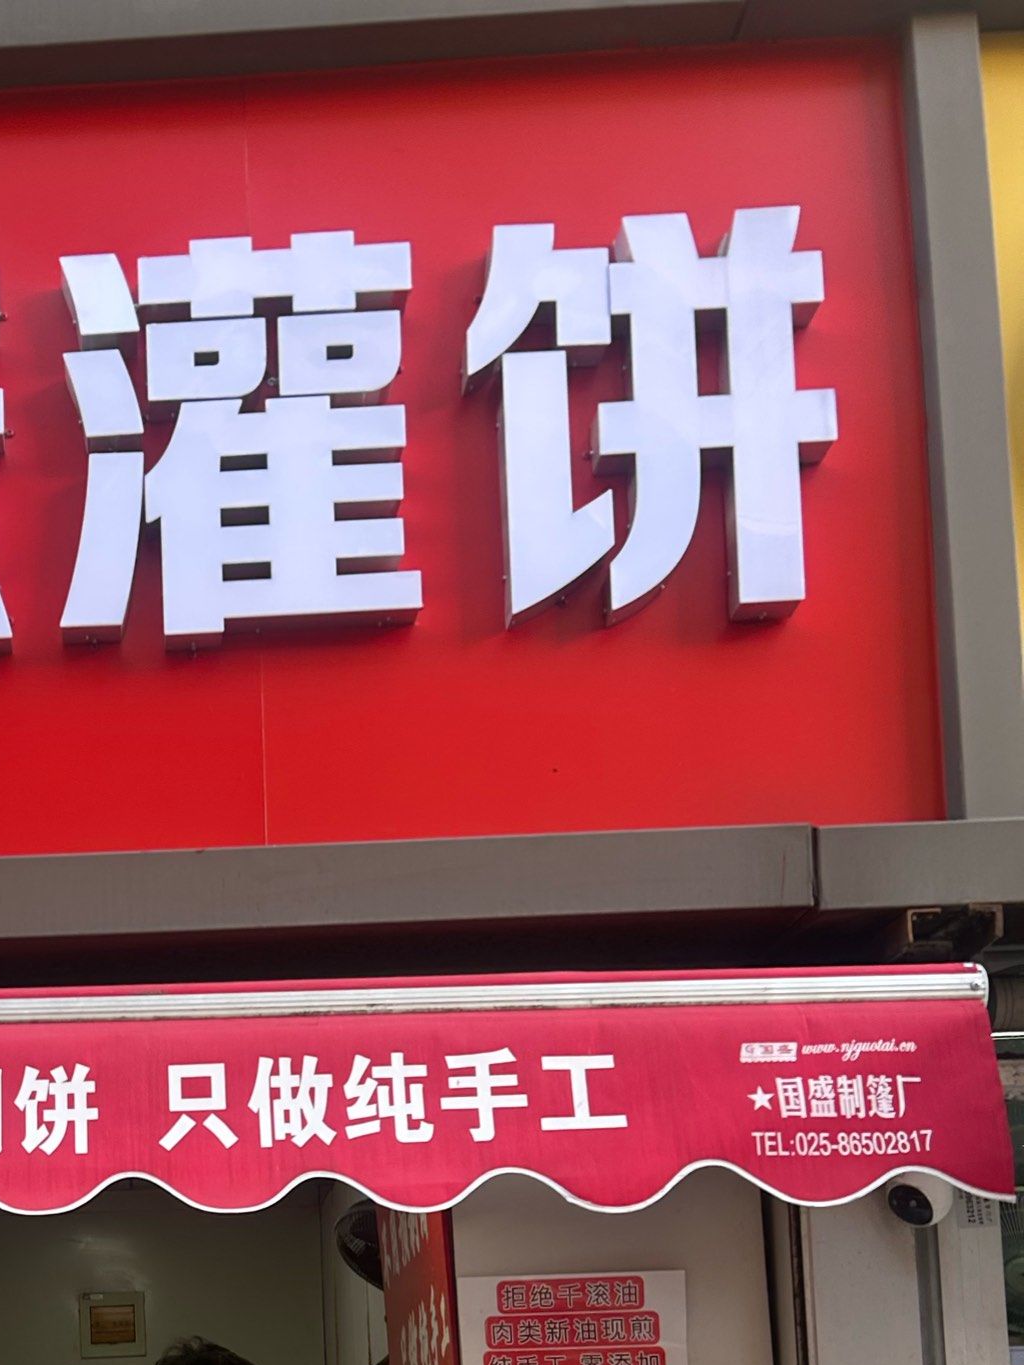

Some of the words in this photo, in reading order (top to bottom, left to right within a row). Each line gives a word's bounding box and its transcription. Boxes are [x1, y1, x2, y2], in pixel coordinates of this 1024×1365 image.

[158, 1046, 629, 1152] 只做纯手工
[775, 1074, 921, 1119] 国盛制篷厂
[752, 1130, 932, 1156] TEL:025-86502817
[501, 1281, 640, 1310] 拒绝千滚油
[490, 1316, 655, 1345] 肉类新油现煎
